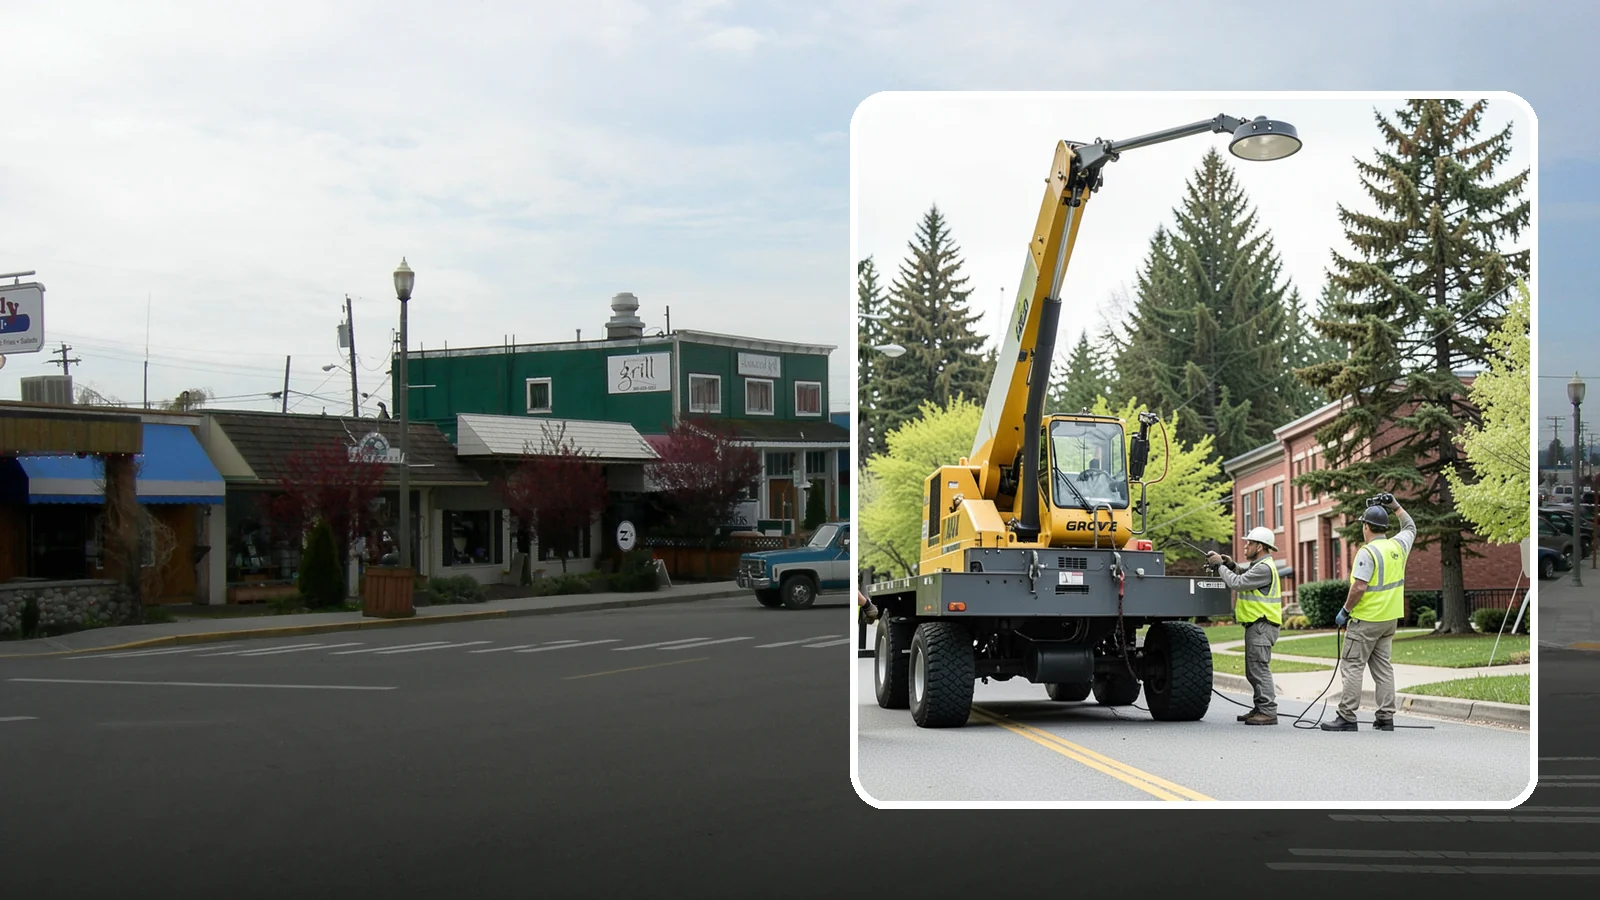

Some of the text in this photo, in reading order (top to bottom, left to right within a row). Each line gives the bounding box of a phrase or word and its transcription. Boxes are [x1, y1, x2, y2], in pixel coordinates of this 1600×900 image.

[20, 337, 38, 345] Salads
[618, 356, 655, 391] grill
[1066, 521, 1118, 532] GROVE
